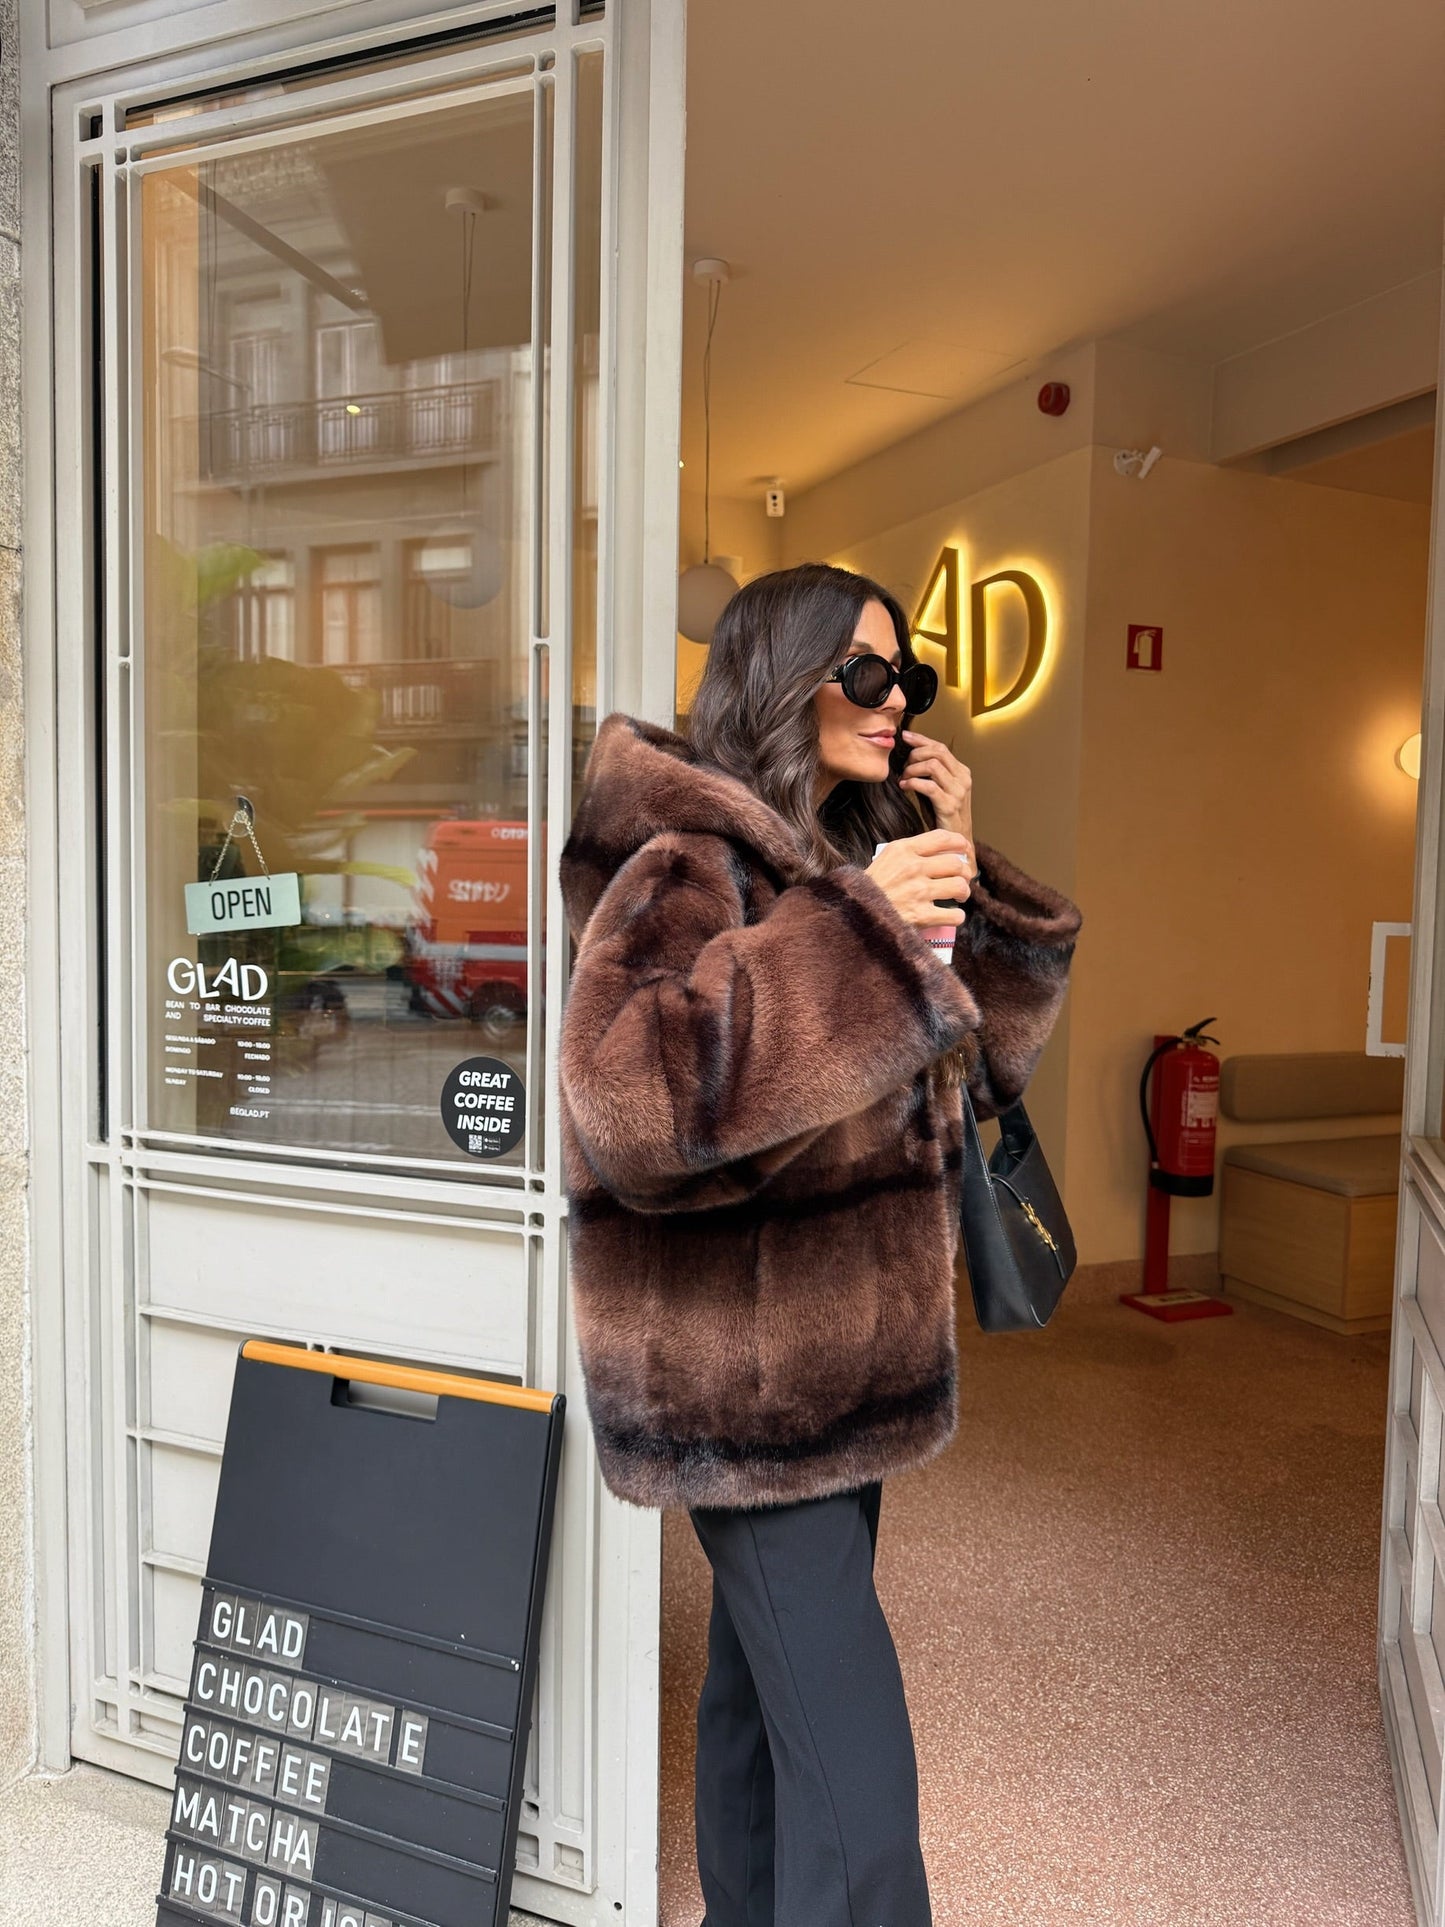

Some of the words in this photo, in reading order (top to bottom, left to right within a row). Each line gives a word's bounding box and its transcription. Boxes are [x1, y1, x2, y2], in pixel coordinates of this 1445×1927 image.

[211, 887, 272, 920] OPEN
[167, 957, 268, 1001] GLAD
[165, 1000, 185, 1009] BEAN
[189, 1002, 201, 1010] TO
[205, 1003, 221, 1012] BAR
[225, 1004, 271, 1016] CHOCOLATE
[165, 1011, 182, 1020] AND
[203, 1013, 242, 1024] SPECIALTY
[242, 1017, 271, 1027] COFFEE
[248, 1086, 271, 1094] CLOSED
[459, 1070, 511, 1089] GREAT
[229, 1106, 270, 1119] BEGLAD.PT
[454, 1092, 515, 1112] COFFEE
[457, 1114, 511, 1134] INSIDE
[212, 1601, 303, 1658] GLAD
[197, 1663, 423, 1764] CHOCOLATE
[187, 1725, 326, 1803] COFFEE
[174, 1786, 311, 1870] MATCHA
[173, 1854, 242, 1911] HOT
[255, 1885, 304, 1927] OR
